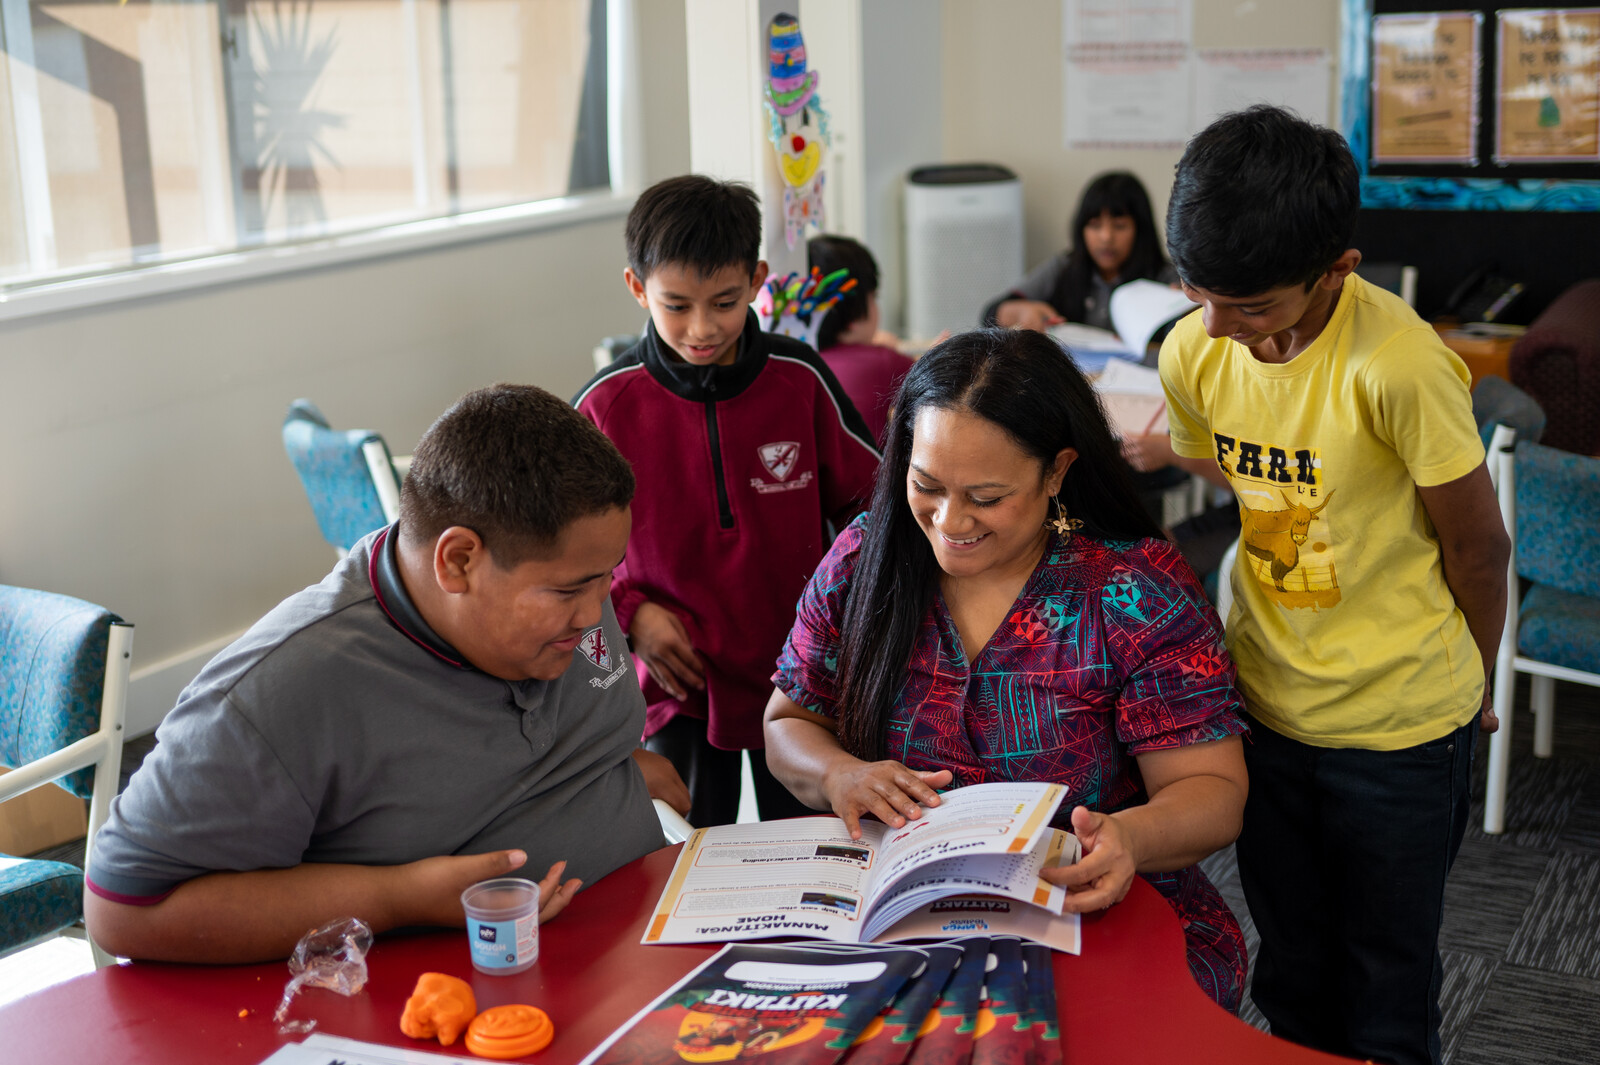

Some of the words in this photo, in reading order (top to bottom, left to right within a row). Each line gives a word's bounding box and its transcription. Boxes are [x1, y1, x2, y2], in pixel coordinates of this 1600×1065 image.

[736, 914, 786, 924] HOME
[695, 922, 829, 934] MANAAKITANGA:
[704, 989, 848, 1011] KAITIAKI
